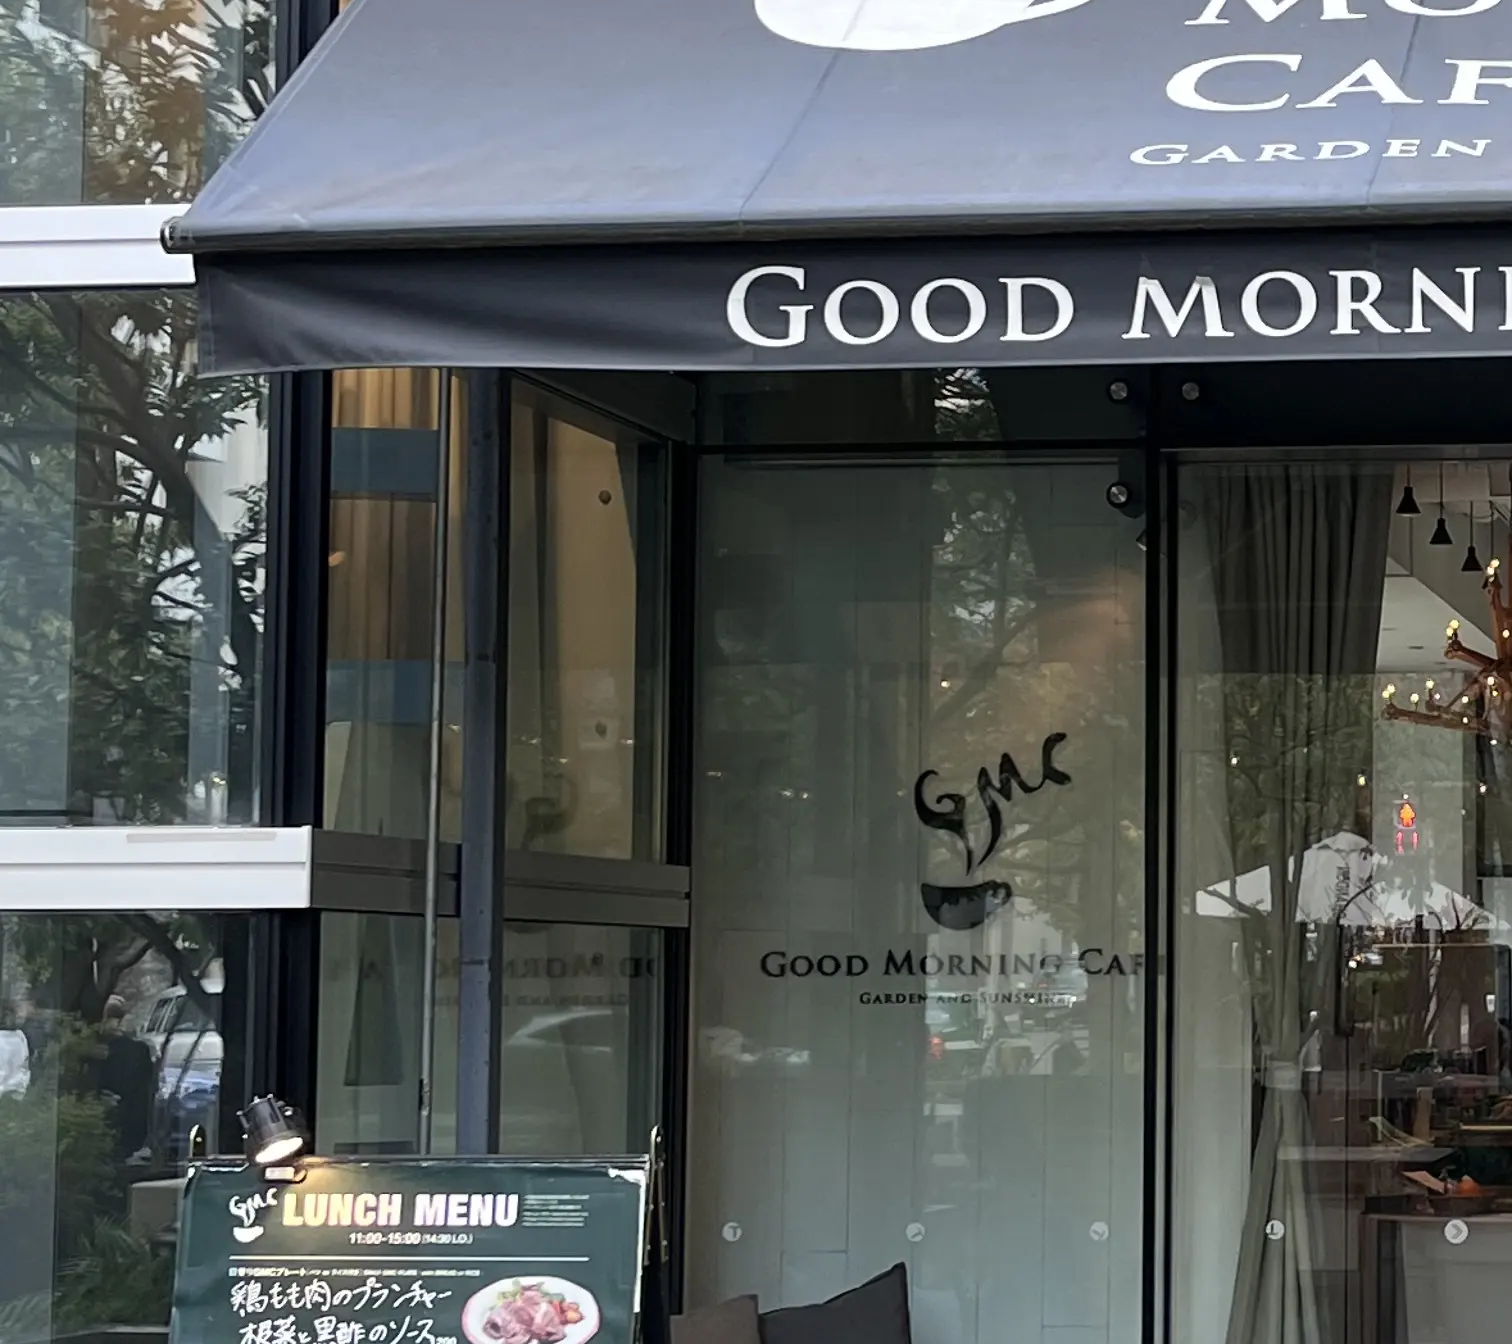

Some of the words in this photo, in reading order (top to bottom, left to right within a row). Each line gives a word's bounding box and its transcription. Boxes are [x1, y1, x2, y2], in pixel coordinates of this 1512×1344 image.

[1129, 139, 1492, 165] GARDEN
[726, 266, 1075, 347] GOOD
[760, 950, 869, 979] GOOD
[883, 949, 1062, 978] MORNING
[859, 992, 928, 1005] GARDEN
[282, 1193, 403, 1227] LUNCH
[413, 1193, 519, 1228] MENU
